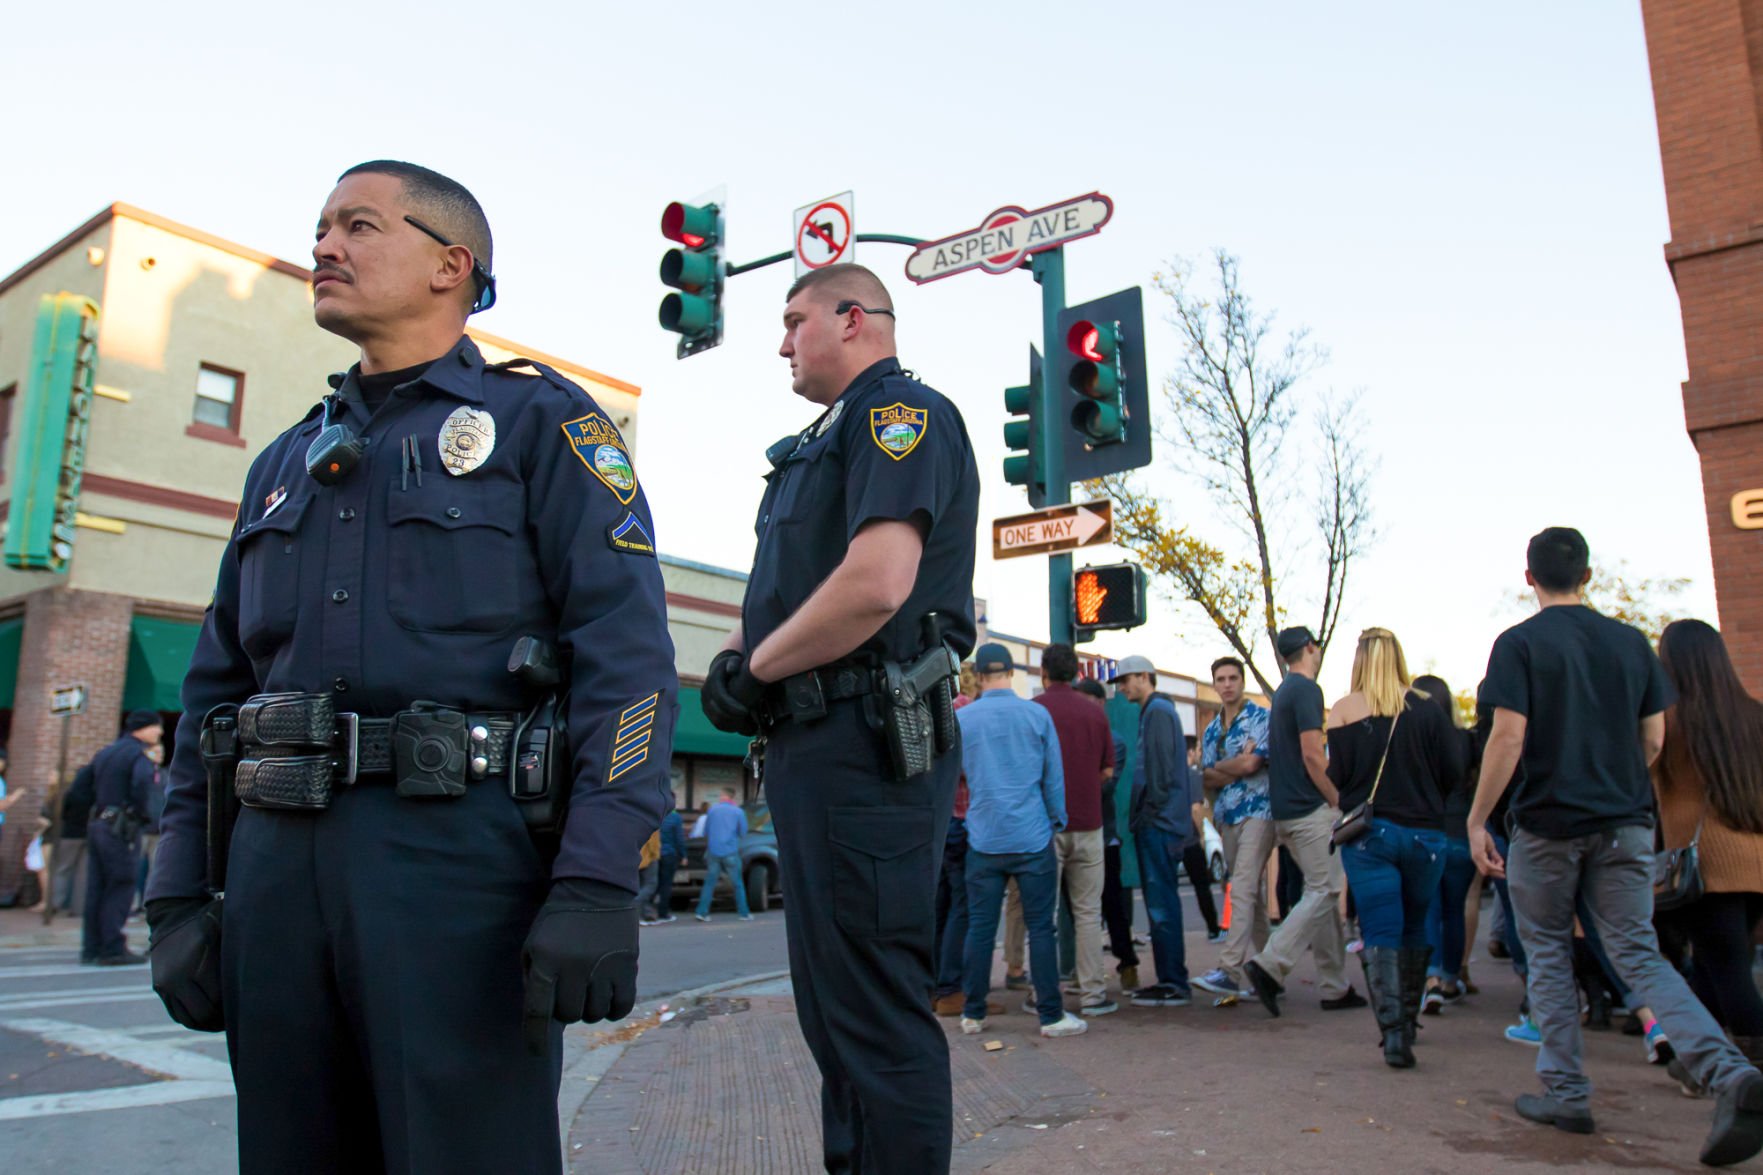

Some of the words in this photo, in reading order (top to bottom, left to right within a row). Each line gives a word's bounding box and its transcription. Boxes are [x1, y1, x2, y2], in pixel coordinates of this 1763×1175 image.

[932, 227, 1014, 271] ASPEN
[1026, 207, 1080, 242] AVE
[881, 408, 918, 419] POLICE
[1004, 526, 1036, 546] ONE
[1042, 519, 1074, 539] WAY
